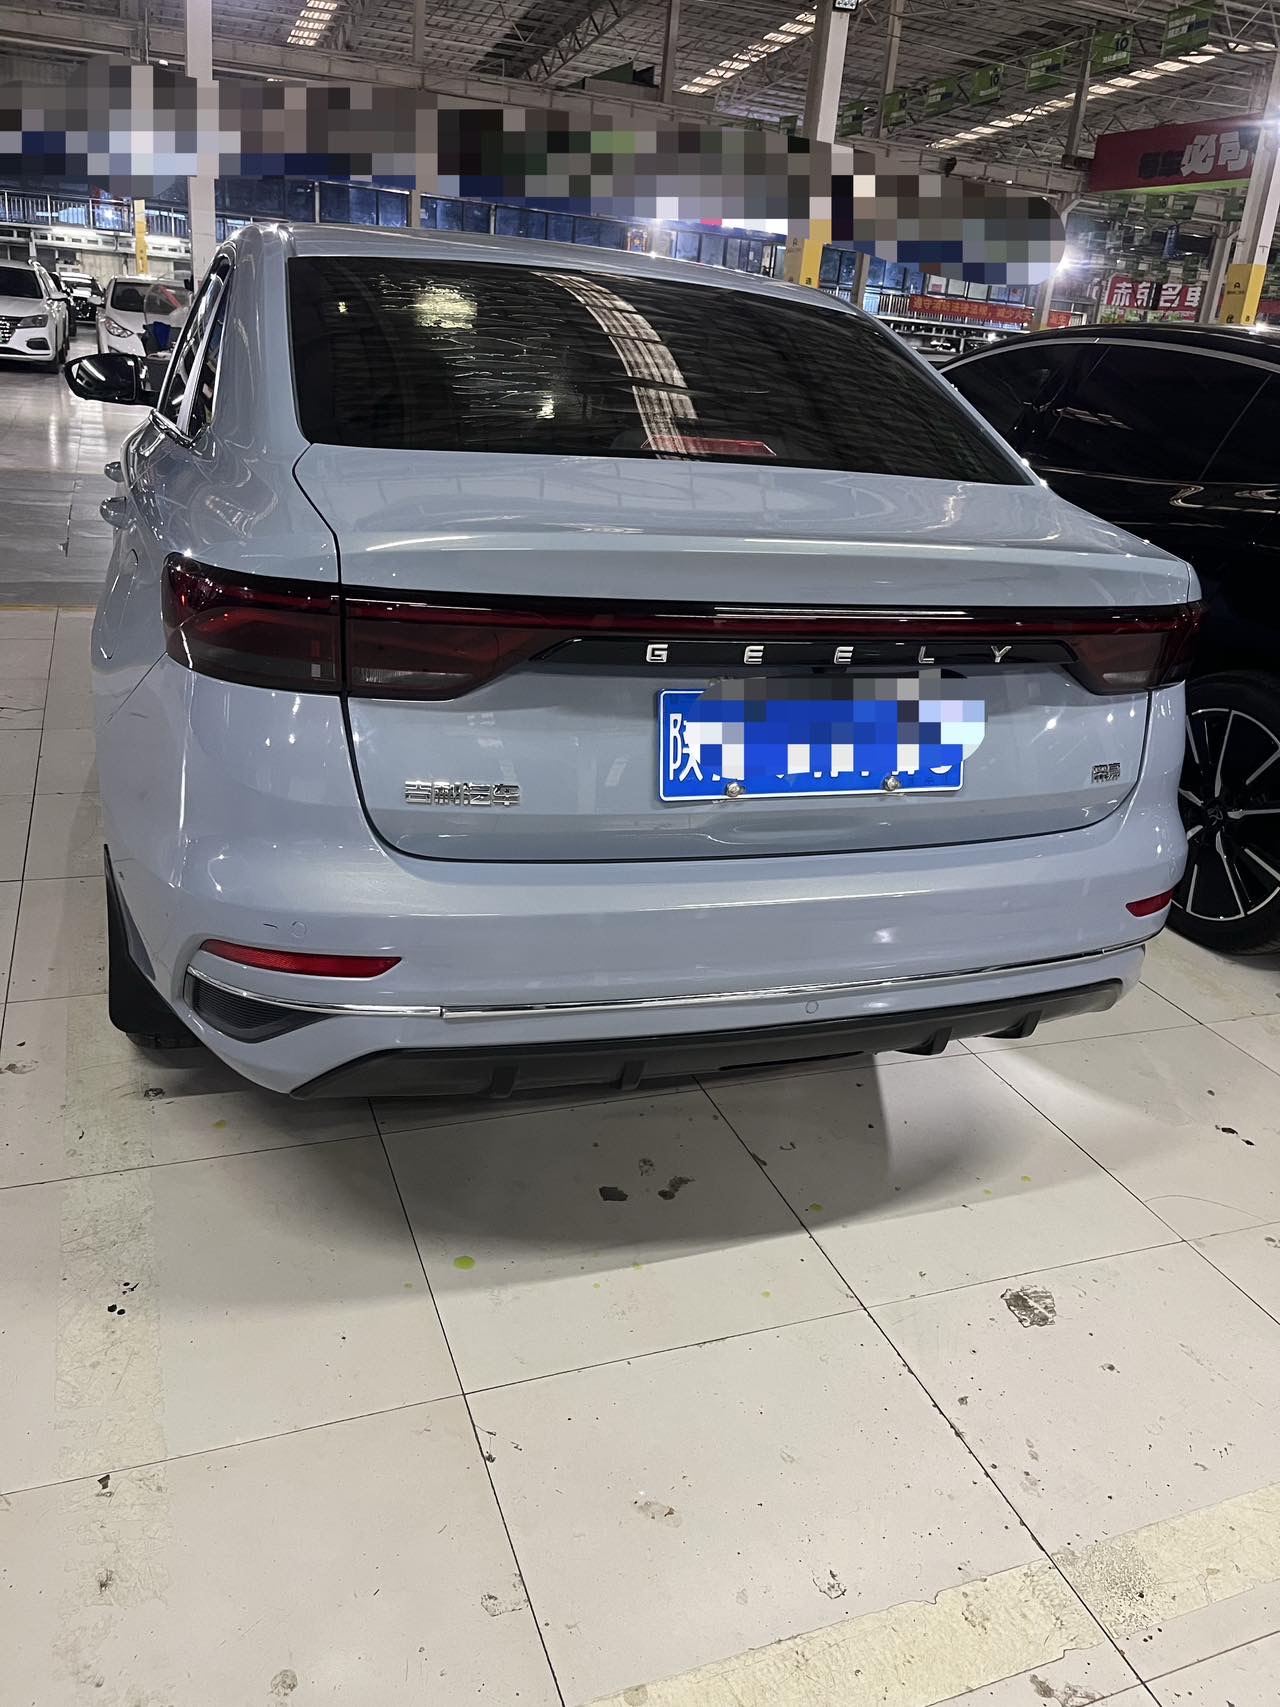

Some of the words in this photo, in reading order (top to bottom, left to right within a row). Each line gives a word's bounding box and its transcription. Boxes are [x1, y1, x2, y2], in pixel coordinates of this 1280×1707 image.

[646, 643, 1012, 664] GEELY
[404, 780, 521, 807] 吉利汽车
